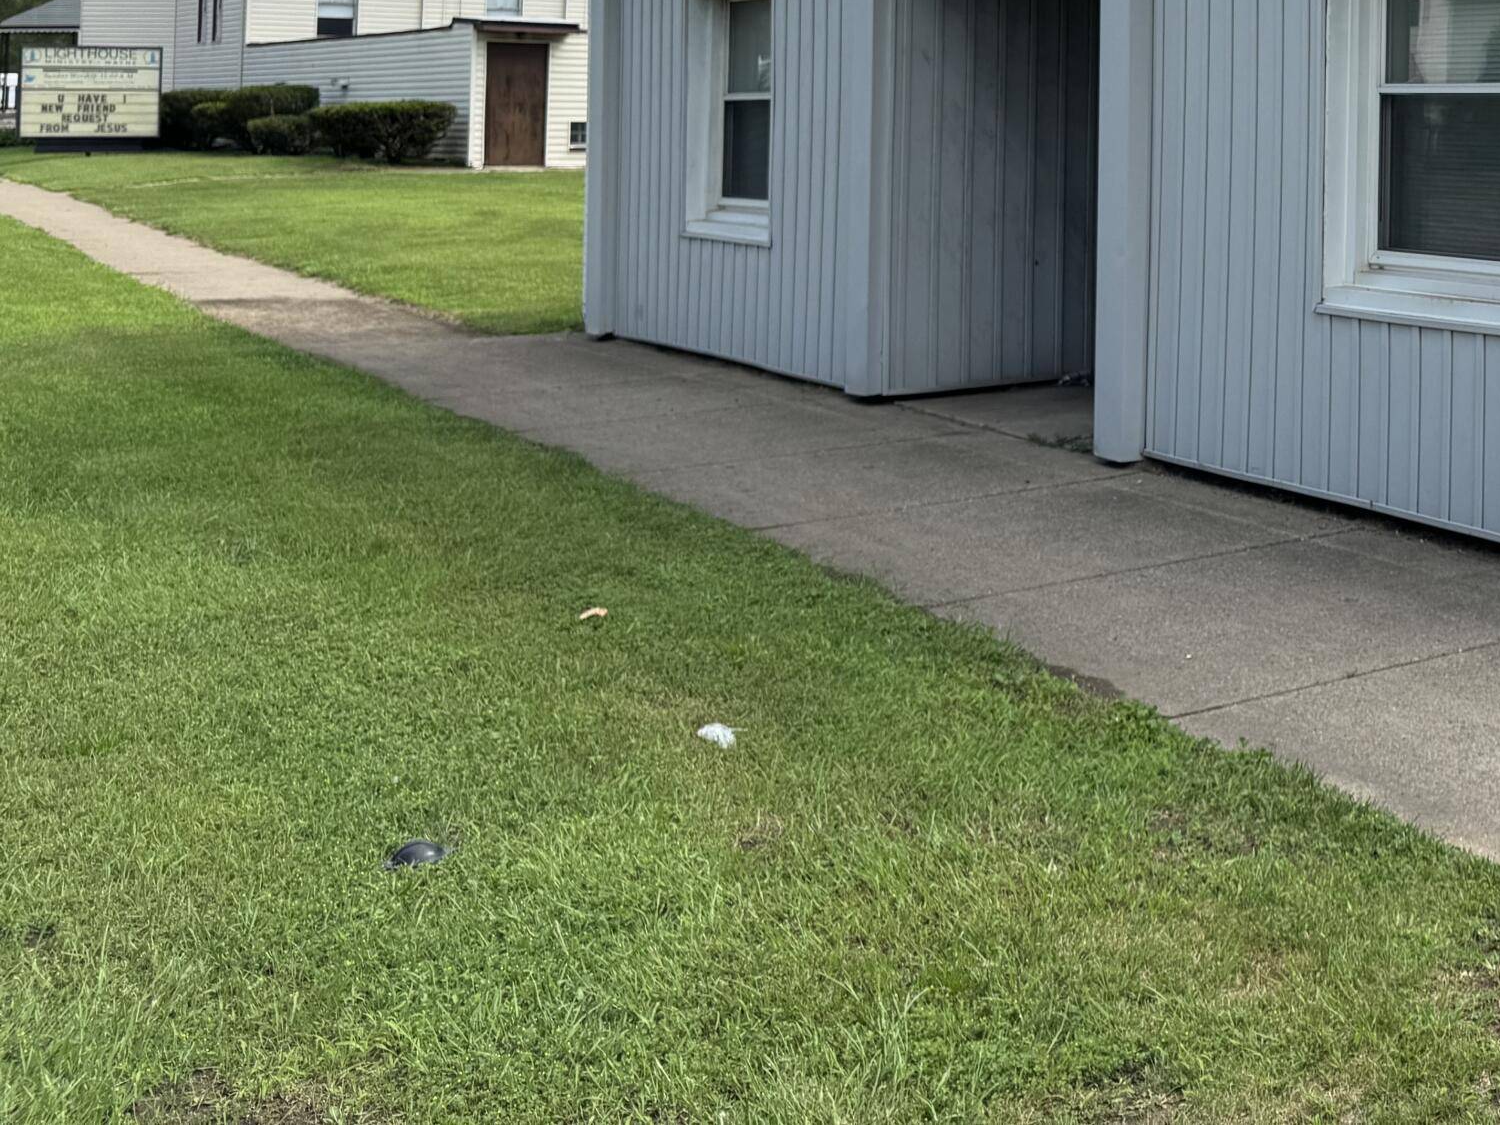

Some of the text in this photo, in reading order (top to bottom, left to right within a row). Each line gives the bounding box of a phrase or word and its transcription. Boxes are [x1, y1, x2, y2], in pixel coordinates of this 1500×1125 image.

[44, 47, 137, 60] LIGHTHOUSE
[58, 94, 65, 103] U
[78, 94, 107, 103] HAVE
[41, 104, 116, 113] NEW FRIEND
[61, 113, 109, 123] REQUEST
[40, 123, 127, 133] FROM JESUS
